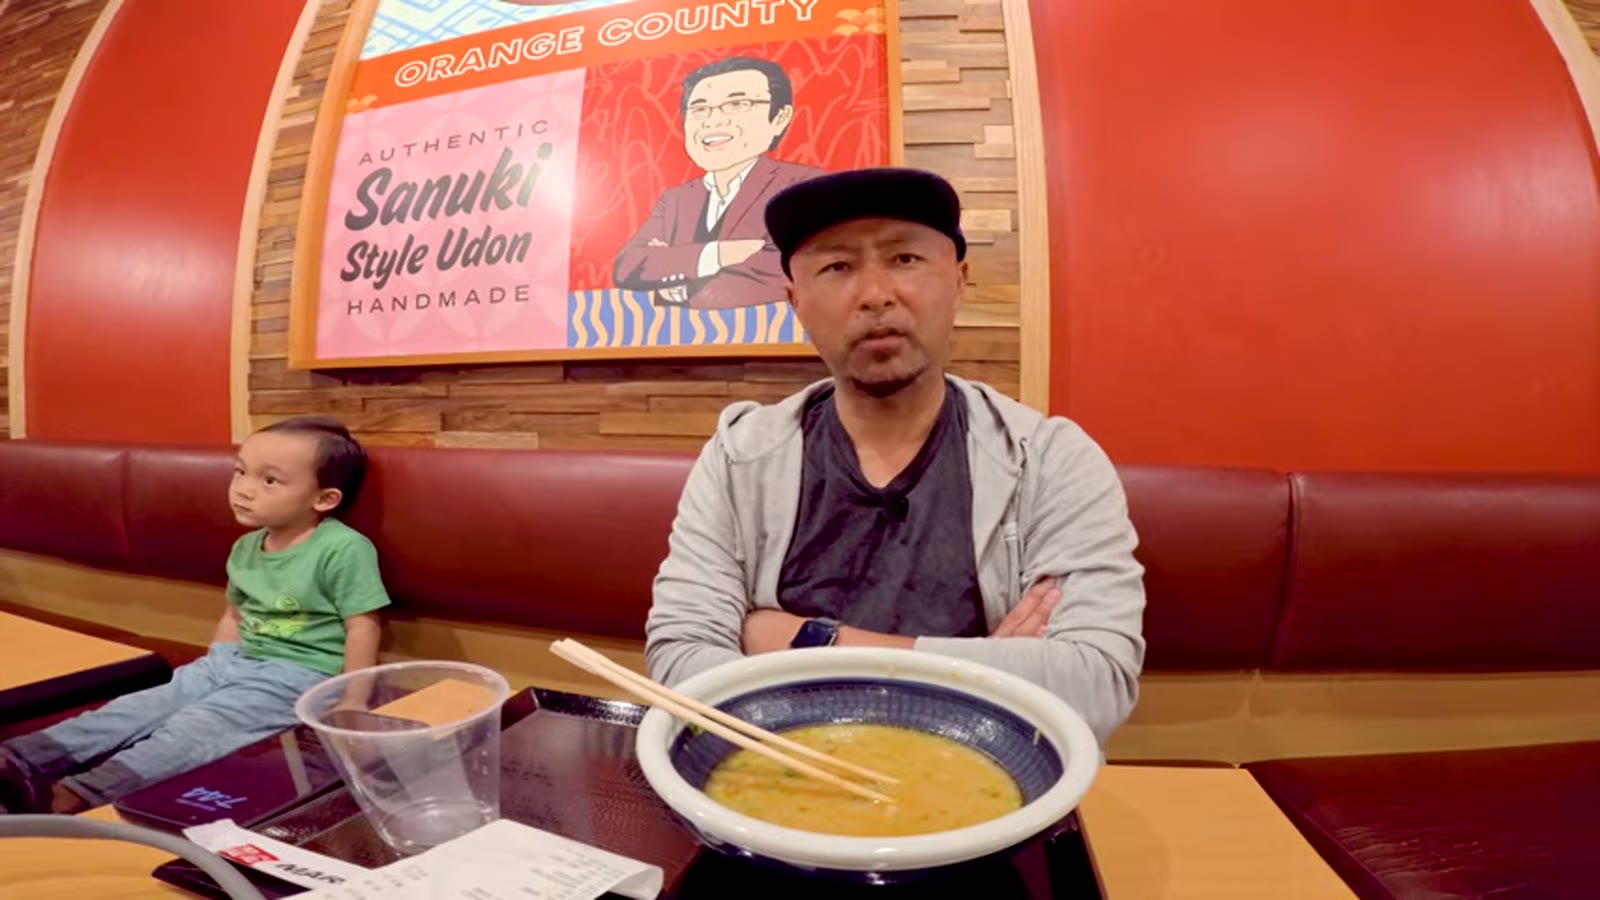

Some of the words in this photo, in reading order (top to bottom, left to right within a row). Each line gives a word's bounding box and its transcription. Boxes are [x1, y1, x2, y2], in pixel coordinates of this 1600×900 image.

[394, 26, 585, 87] ORANGE
[597, 0, 819, 46] COUNTY
[358, 119, 549, 166] AUTHENTIC
[344, 142, 554, 231] Sanuki
[340, 233, 430, 291] Style
[436, 224, 533, 271] Udon
[347, 284, 530, 316] HANDMADE
